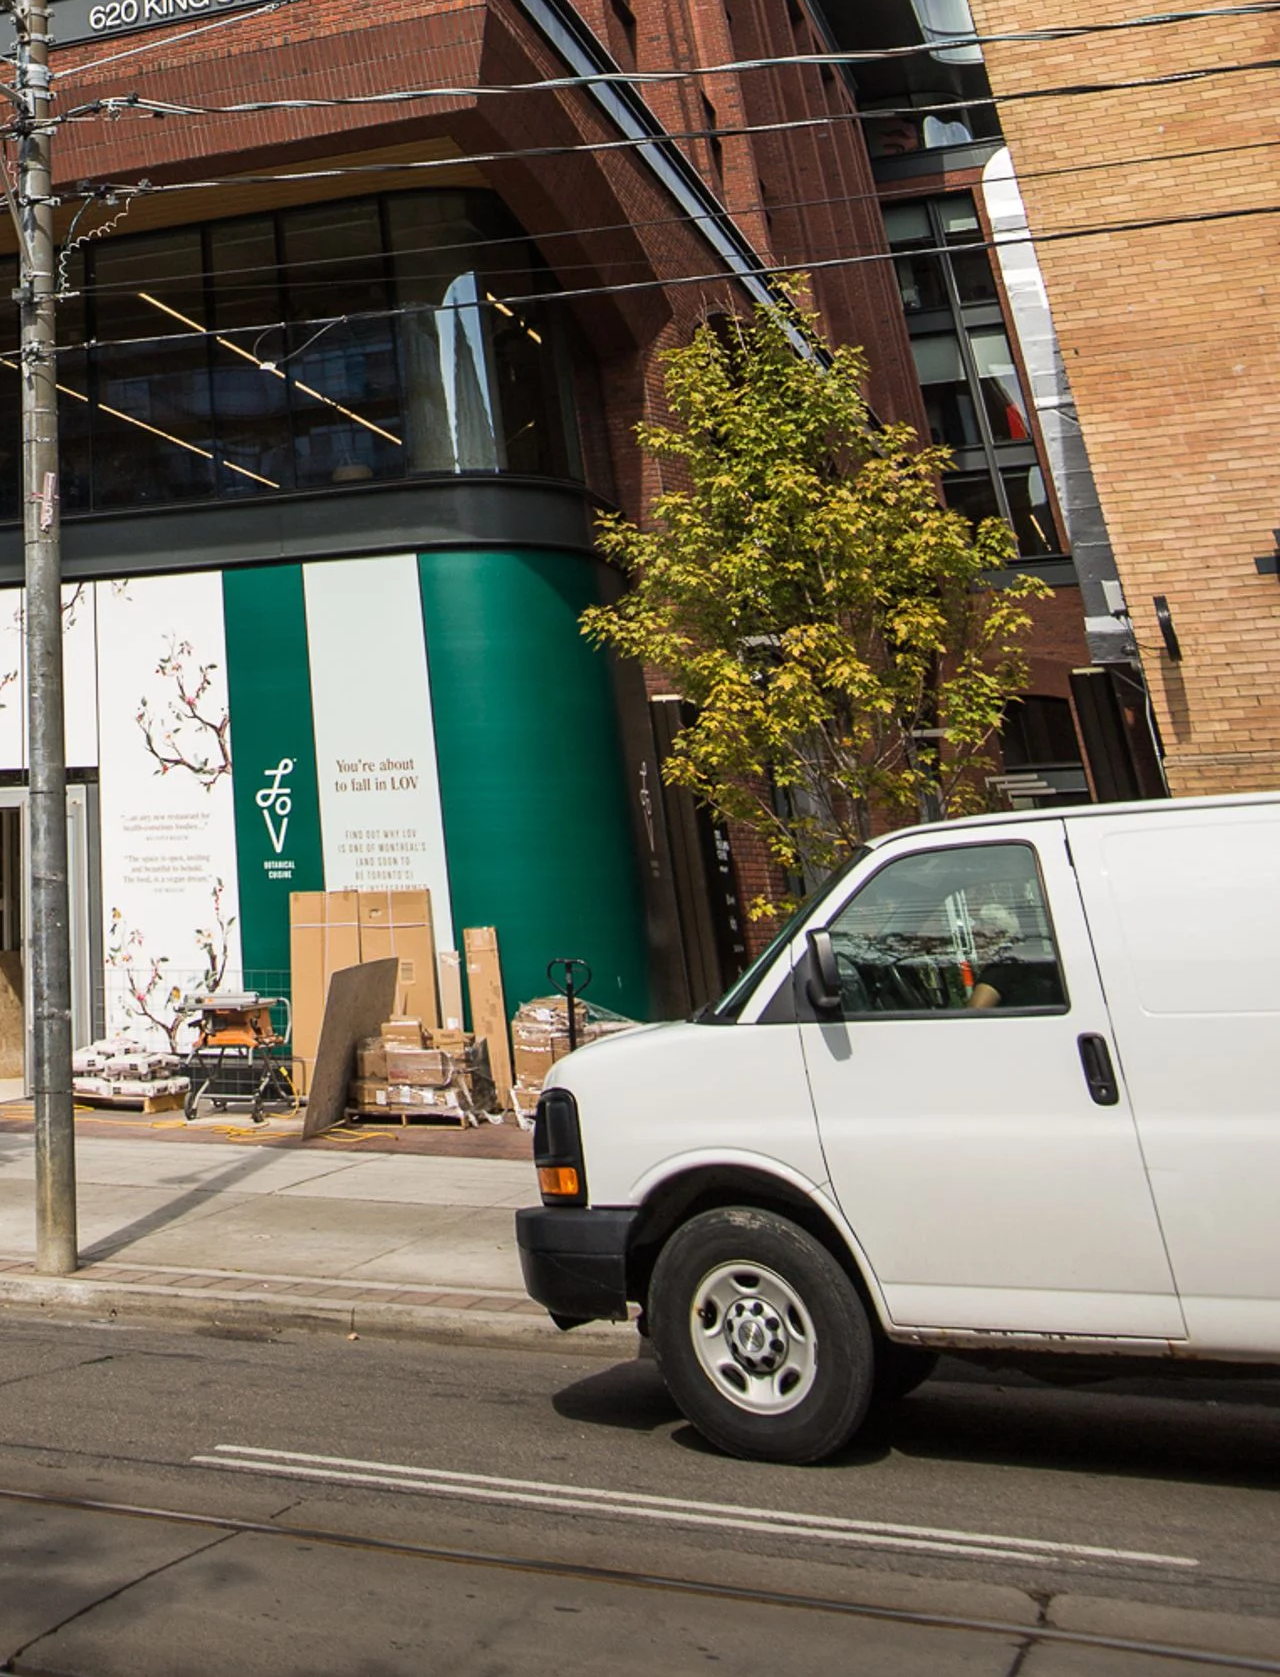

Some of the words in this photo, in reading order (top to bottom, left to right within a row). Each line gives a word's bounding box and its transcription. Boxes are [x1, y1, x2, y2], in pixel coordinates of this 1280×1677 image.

[89, 0, 138, 30] 620
[336, 759, 375, 772] You're
[379, 758, 414, 771] about
[335, 779, 347, 792] to
[351, 778, 371, 792] fall
[375, 778, 387, 791] in
[391, 776, 418, 791] LOV
[345, 830, 363, 840] FIND
[366, 830, 380, 840] OUT
[383, 829, 399, 839] WHY
[402, 828, 417, 839] LOV
[337, 843, 347, 853] IS
[349, 843, 363, 853] ONE
[366, 843, 375, 853] OF
[378, 856, 399, 867] SOON
[401, 856, 411, 866] TO
